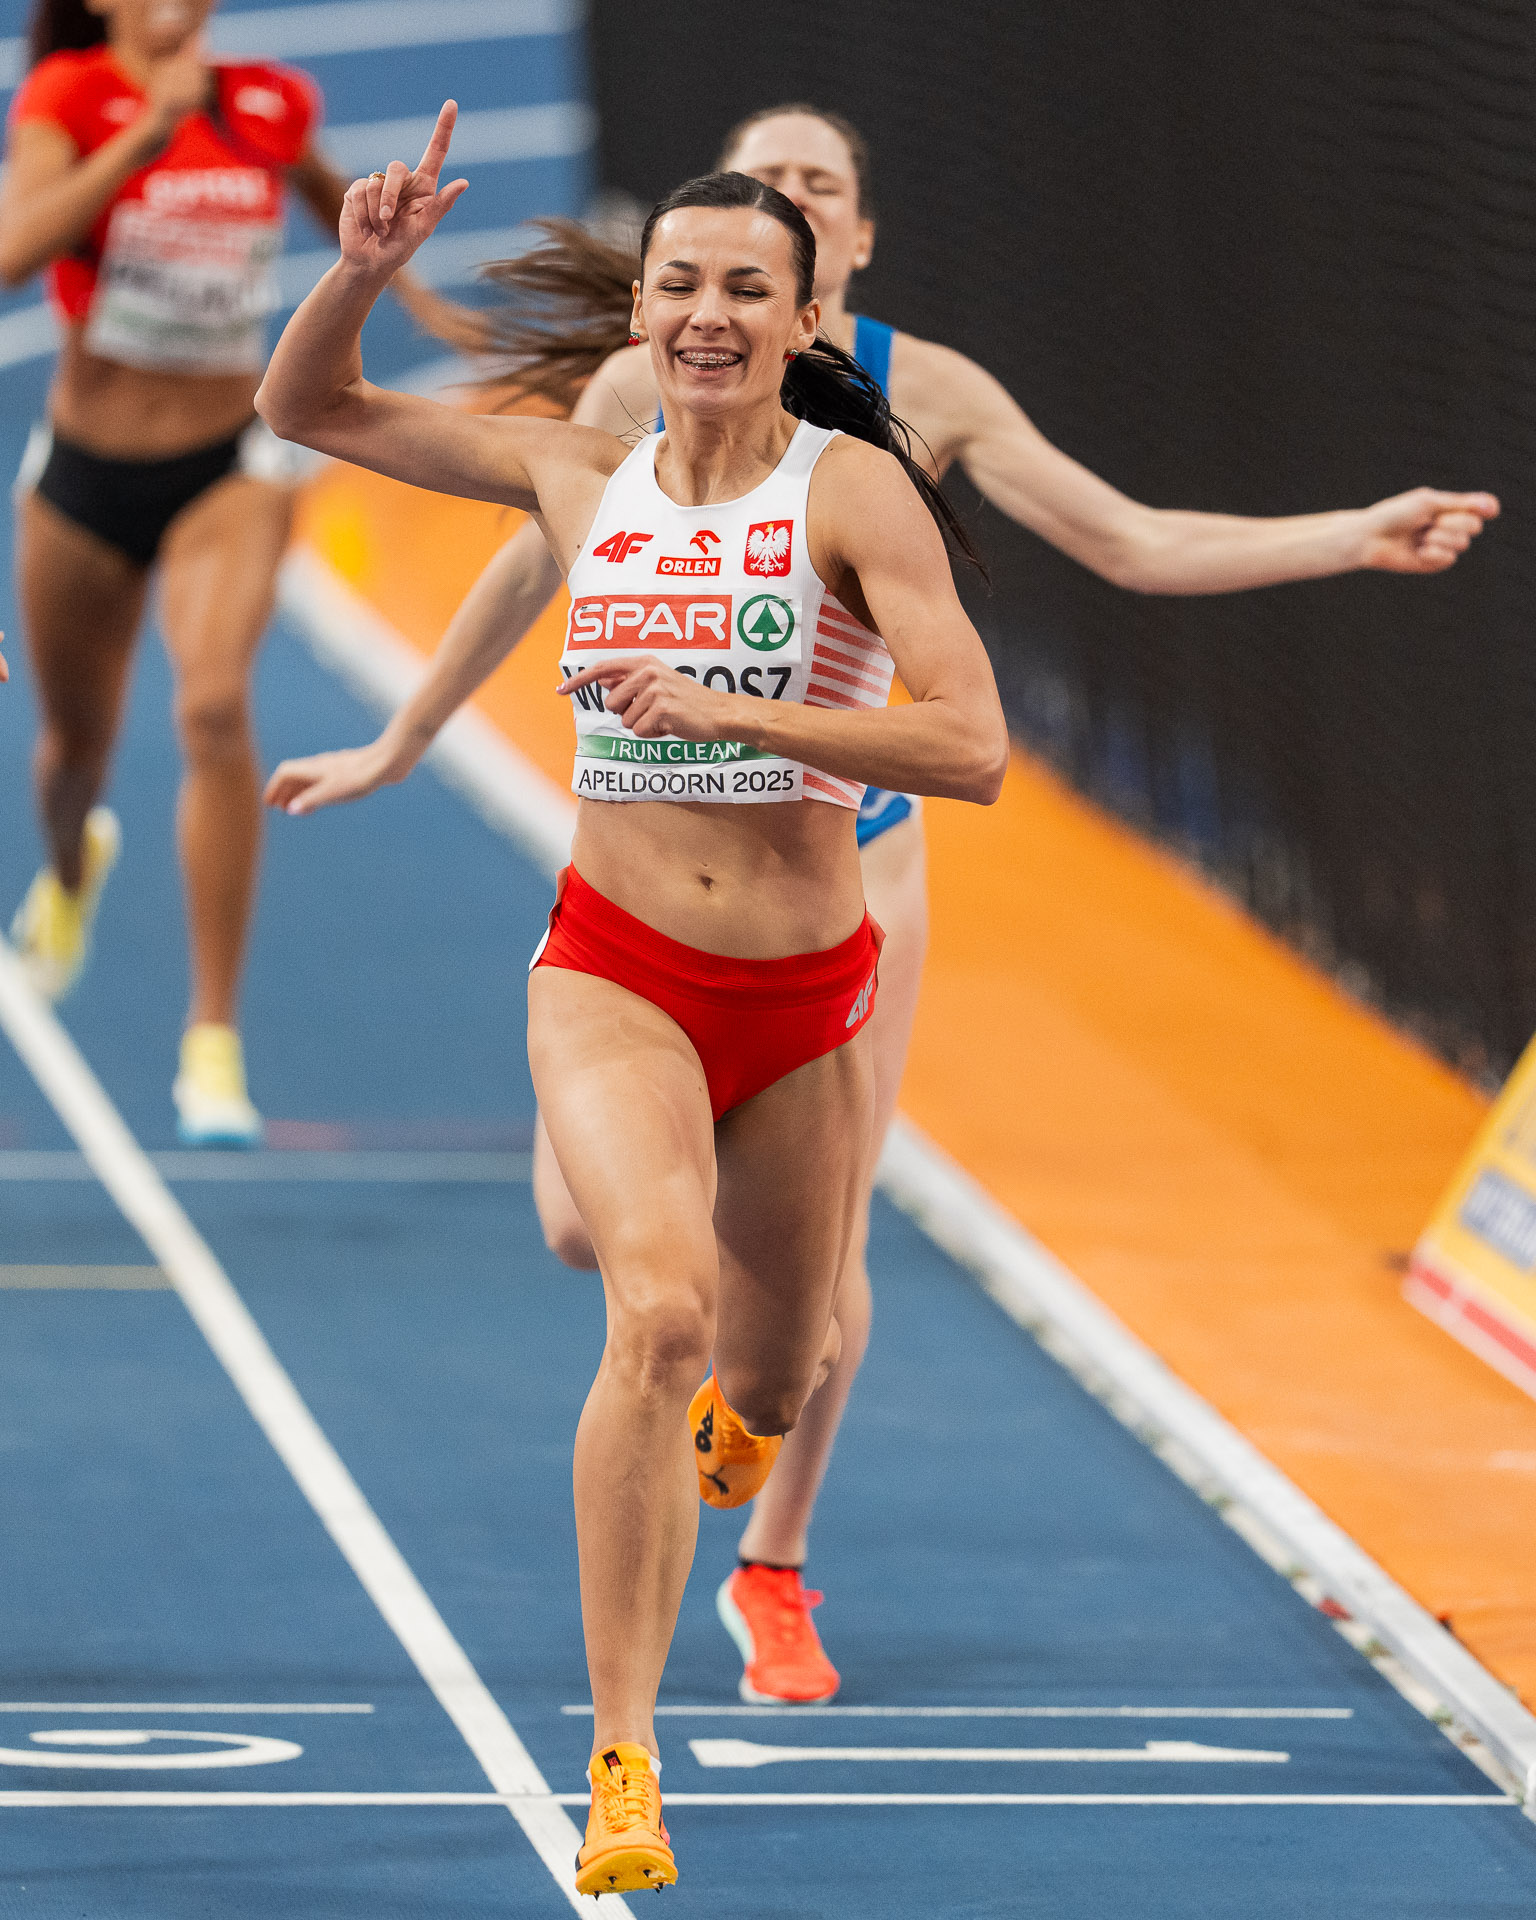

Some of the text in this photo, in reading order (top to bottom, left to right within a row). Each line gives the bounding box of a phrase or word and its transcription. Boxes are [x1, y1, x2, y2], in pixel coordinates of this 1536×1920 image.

[592, 530, 654, 563] 4F
[660, 559, 717, 574] ORLEN
[572, 602, 727, 642] SPAR
[610, 740, 741, 762] I RUN CLEAN
[578, 768, 795, 795] APELDOORN 2025
